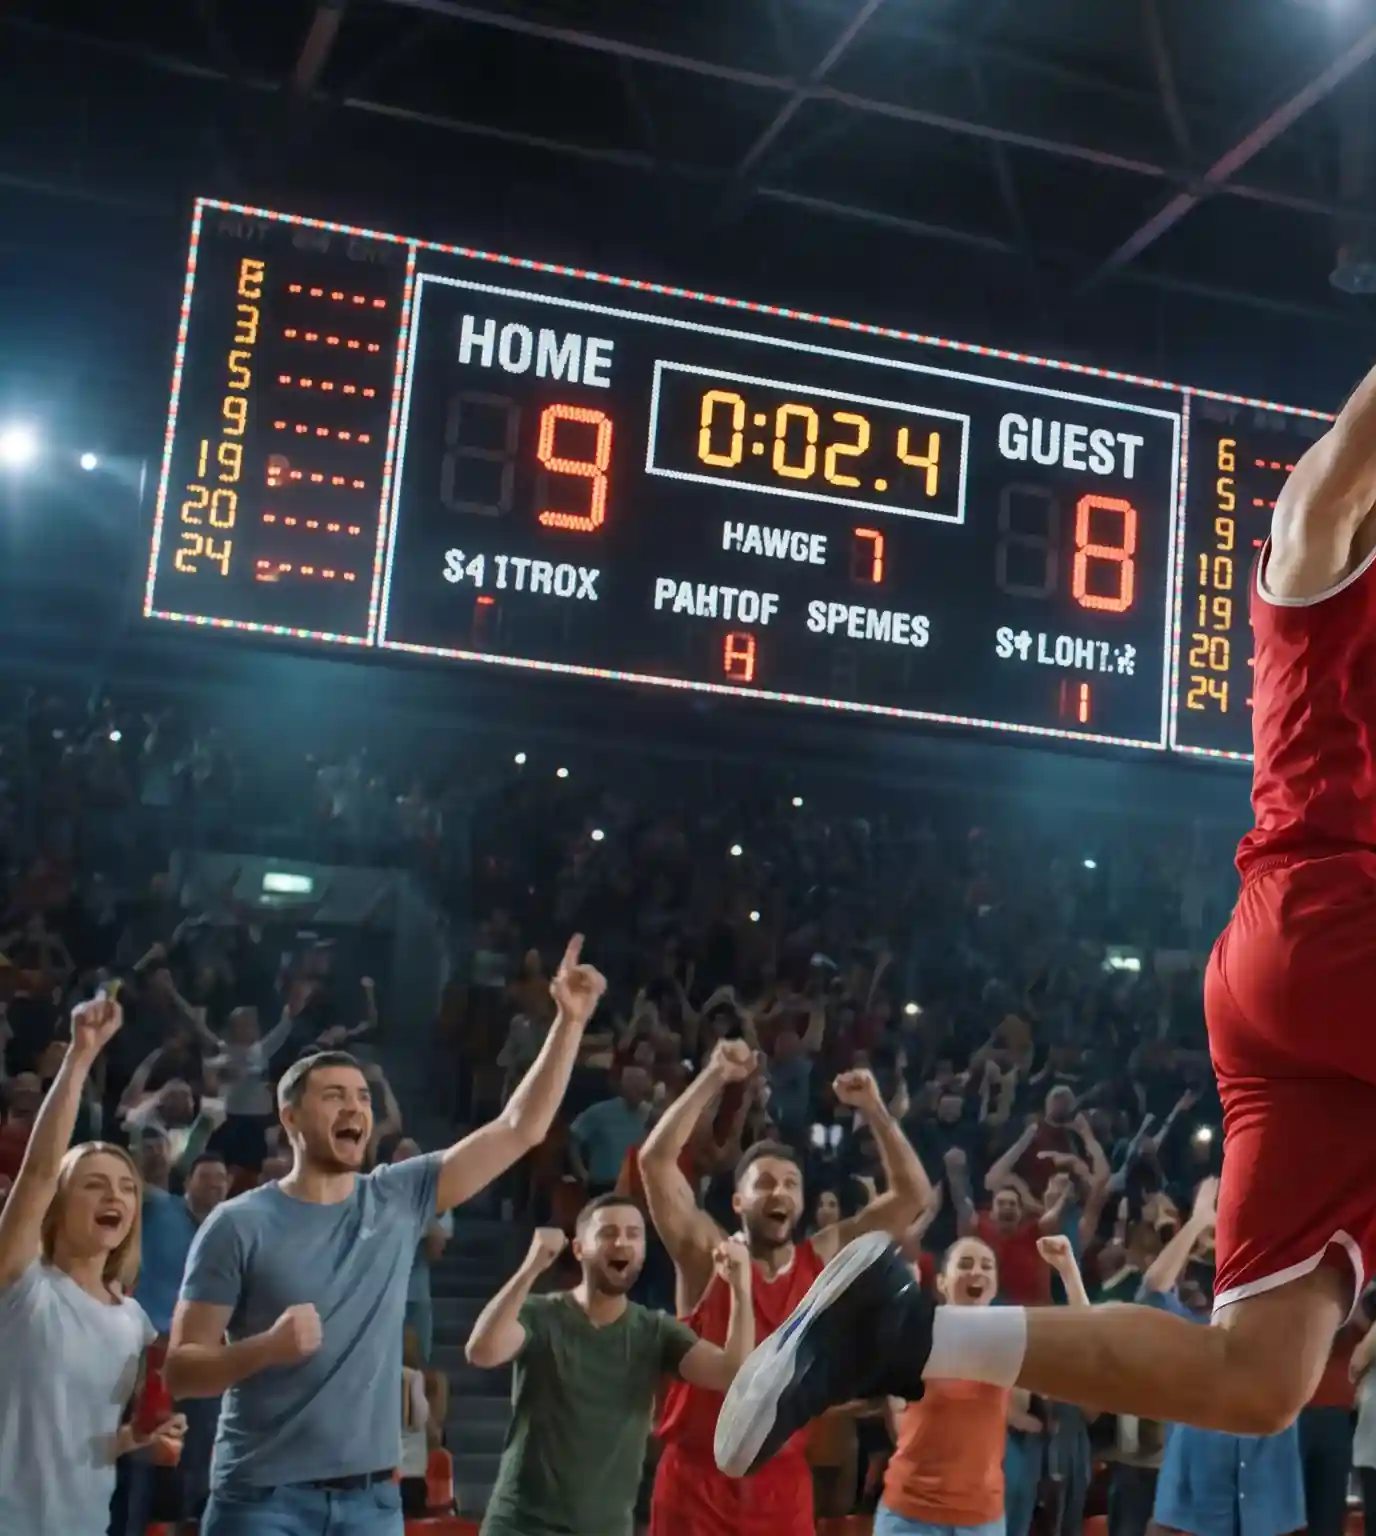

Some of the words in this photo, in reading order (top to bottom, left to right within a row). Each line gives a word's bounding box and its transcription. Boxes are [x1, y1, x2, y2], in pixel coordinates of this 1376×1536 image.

[234, 304, 259, 344] 3
[228, 350, 251, 389] 5
[458, 314, 615, 388] HOME
[223, 396, 248, 436] 9
[198, 439, 243, 482] 19
[698, 390, 941, 497] 0:02.4
[998, 412, 1144, 479] GUEST
[1217, 438, 1236, 472] 6
[536, 403, 613, 532] 9
[181, 484, 238, 529] 20
[1216, 477, 1236, 511] 5
[174, 531, 232, 576] 24
[722, 520, 828, 565] HAWGE
[854, 527, 884, 583] 7
[1071, 494, 1138, 613] 8
[1215, 517, 1235, 551] 9
[1199, 553, 1233, 590] 10
[806, 600, 931, 648] SPEMES
[1198, 594, 1233, 631] 19
[1189, 633, 1230, 671] 20
[1186, 675, 1229, 713] 24
